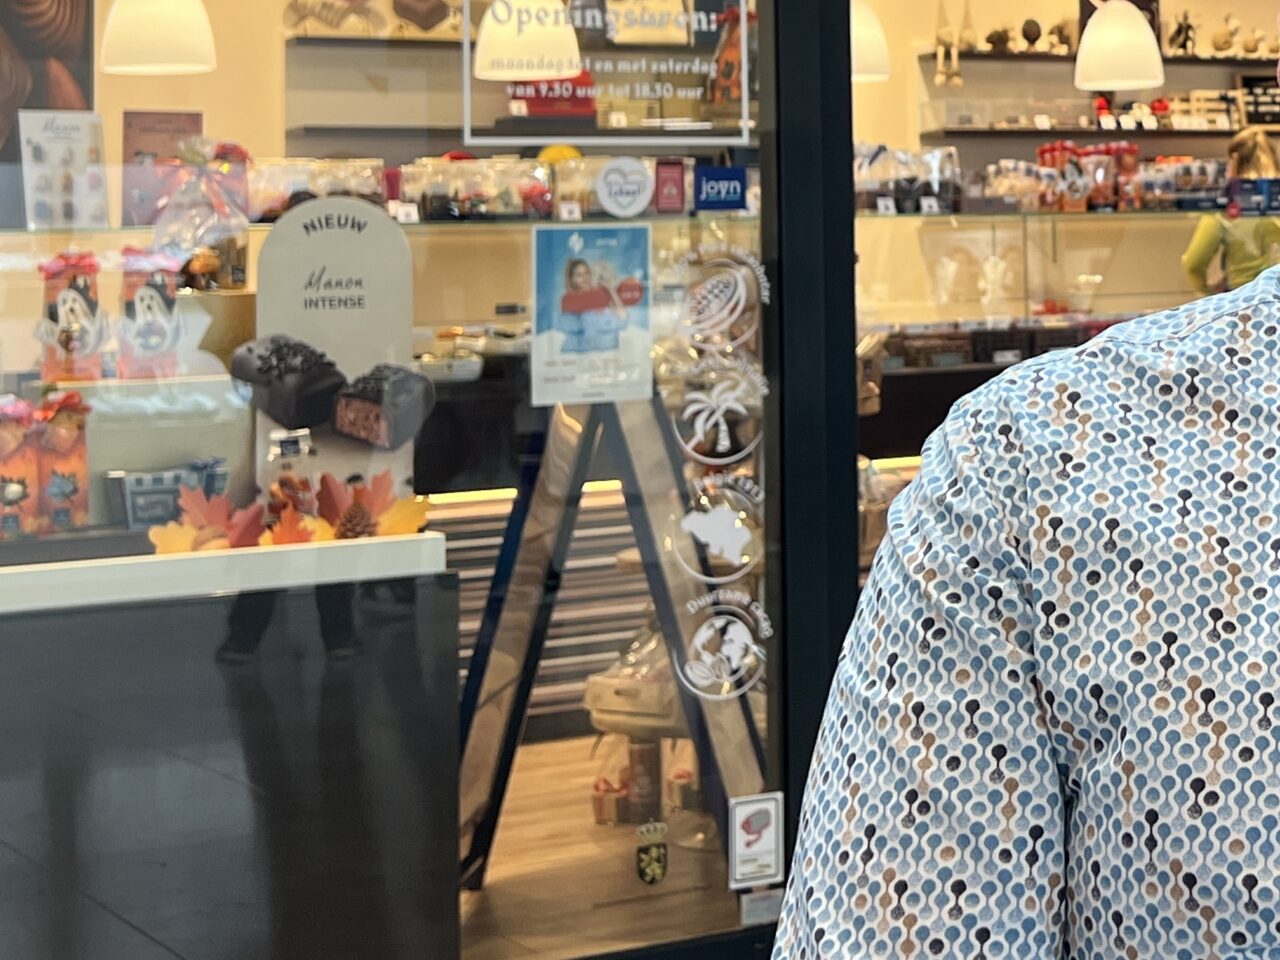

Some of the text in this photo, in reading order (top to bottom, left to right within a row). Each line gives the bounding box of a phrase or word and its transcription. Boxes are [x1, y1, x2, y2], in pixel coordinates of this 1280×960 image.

[700, 177, 741, 201] joyn
[303, 213, 368, 237] NIEUW
[304, 265, 364, 292] Manon
[304, 295, 366, 311] INTENSE
